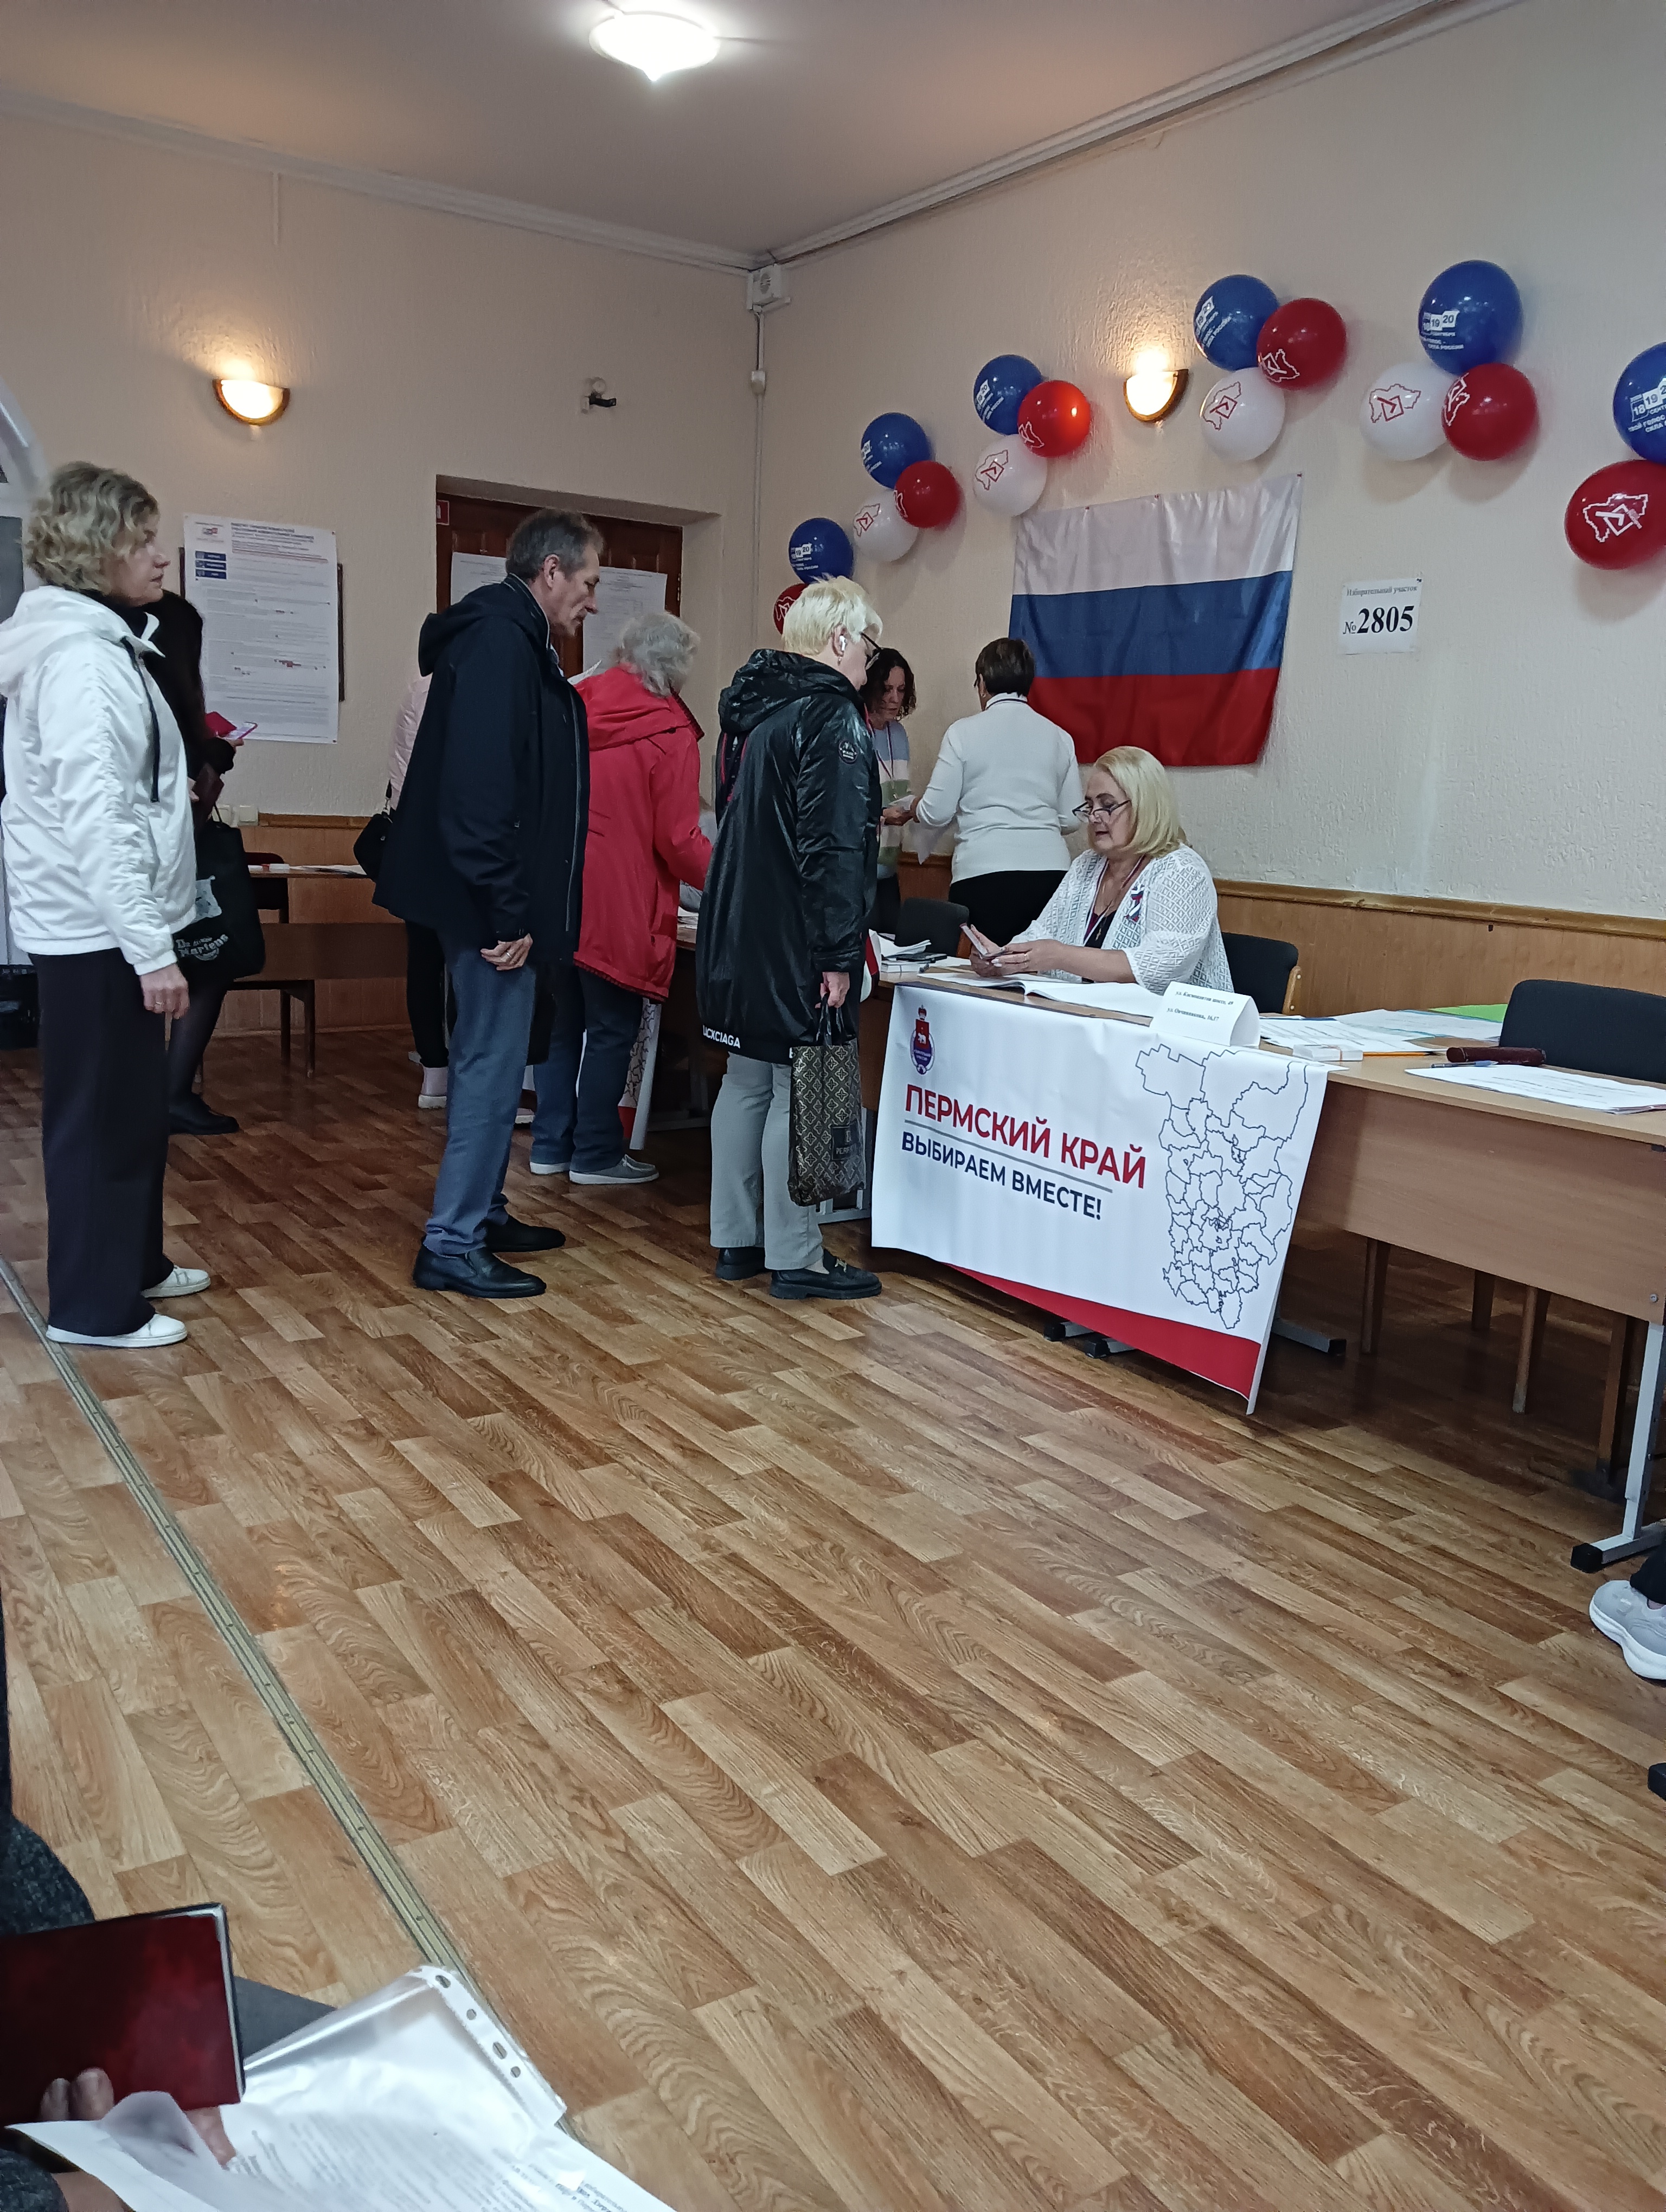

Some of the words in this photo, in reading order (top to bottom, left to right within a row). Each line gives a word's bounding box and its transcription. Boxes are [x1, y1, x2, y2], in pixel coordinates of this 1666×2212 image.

[1443, 314, 1454, 324] 20
[1634, 404, 1646, 415] 18
[1645, 394, 1658, 405] 19
[1393, 586, 1417, 595] участок
[905, 1083, 1051, 1159] ПЕРМСКИЙ
[1061, 1132, 1146, 1189] КРАЙ
[901, 1131, 1006, 1186] ВЫБИРАЕМ
[1012, 1169, 1102, 1220] ВМЕСТЕ!
